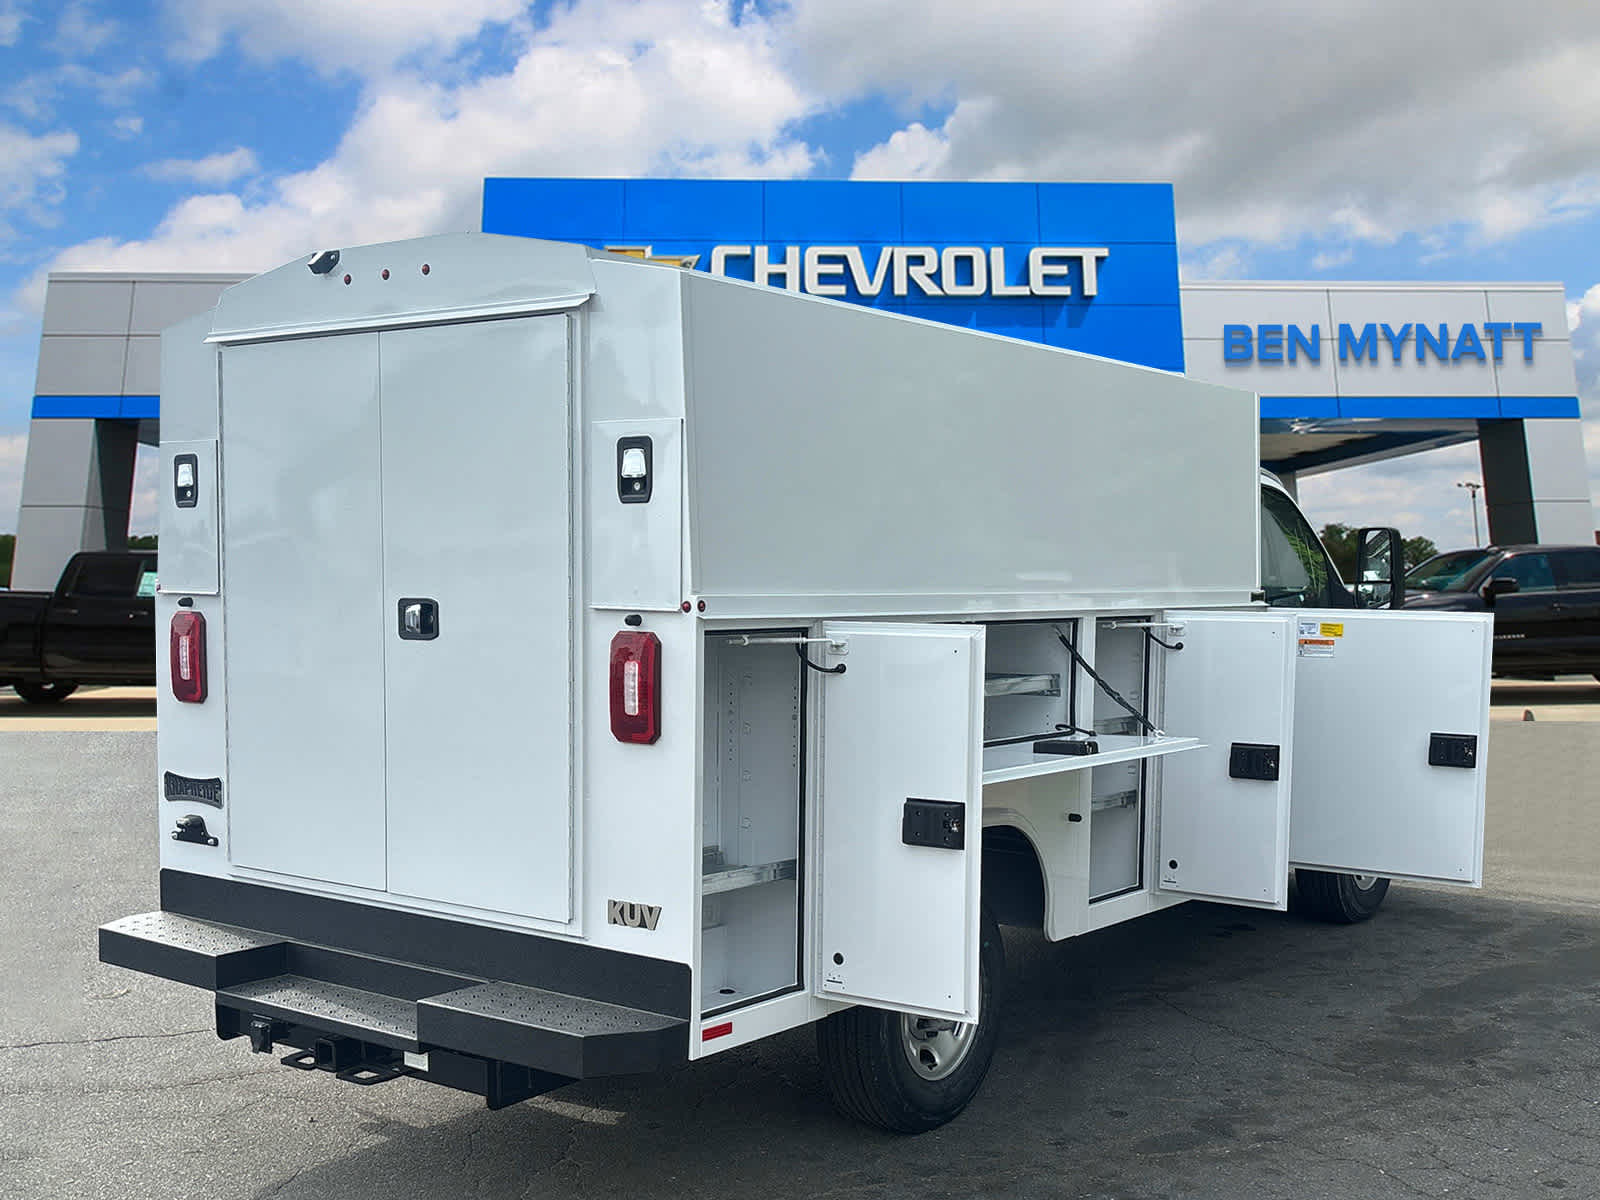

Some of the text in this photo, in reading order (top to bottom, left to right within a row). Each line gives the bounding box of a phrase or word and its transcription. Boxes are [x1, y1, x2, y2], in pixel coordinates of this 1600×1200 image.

[711, 245, 1110, 296] CHEVROLET
[1223, 322, 1543, 362] BEN MYNATT
[608, 899, 662, 930] KUV
